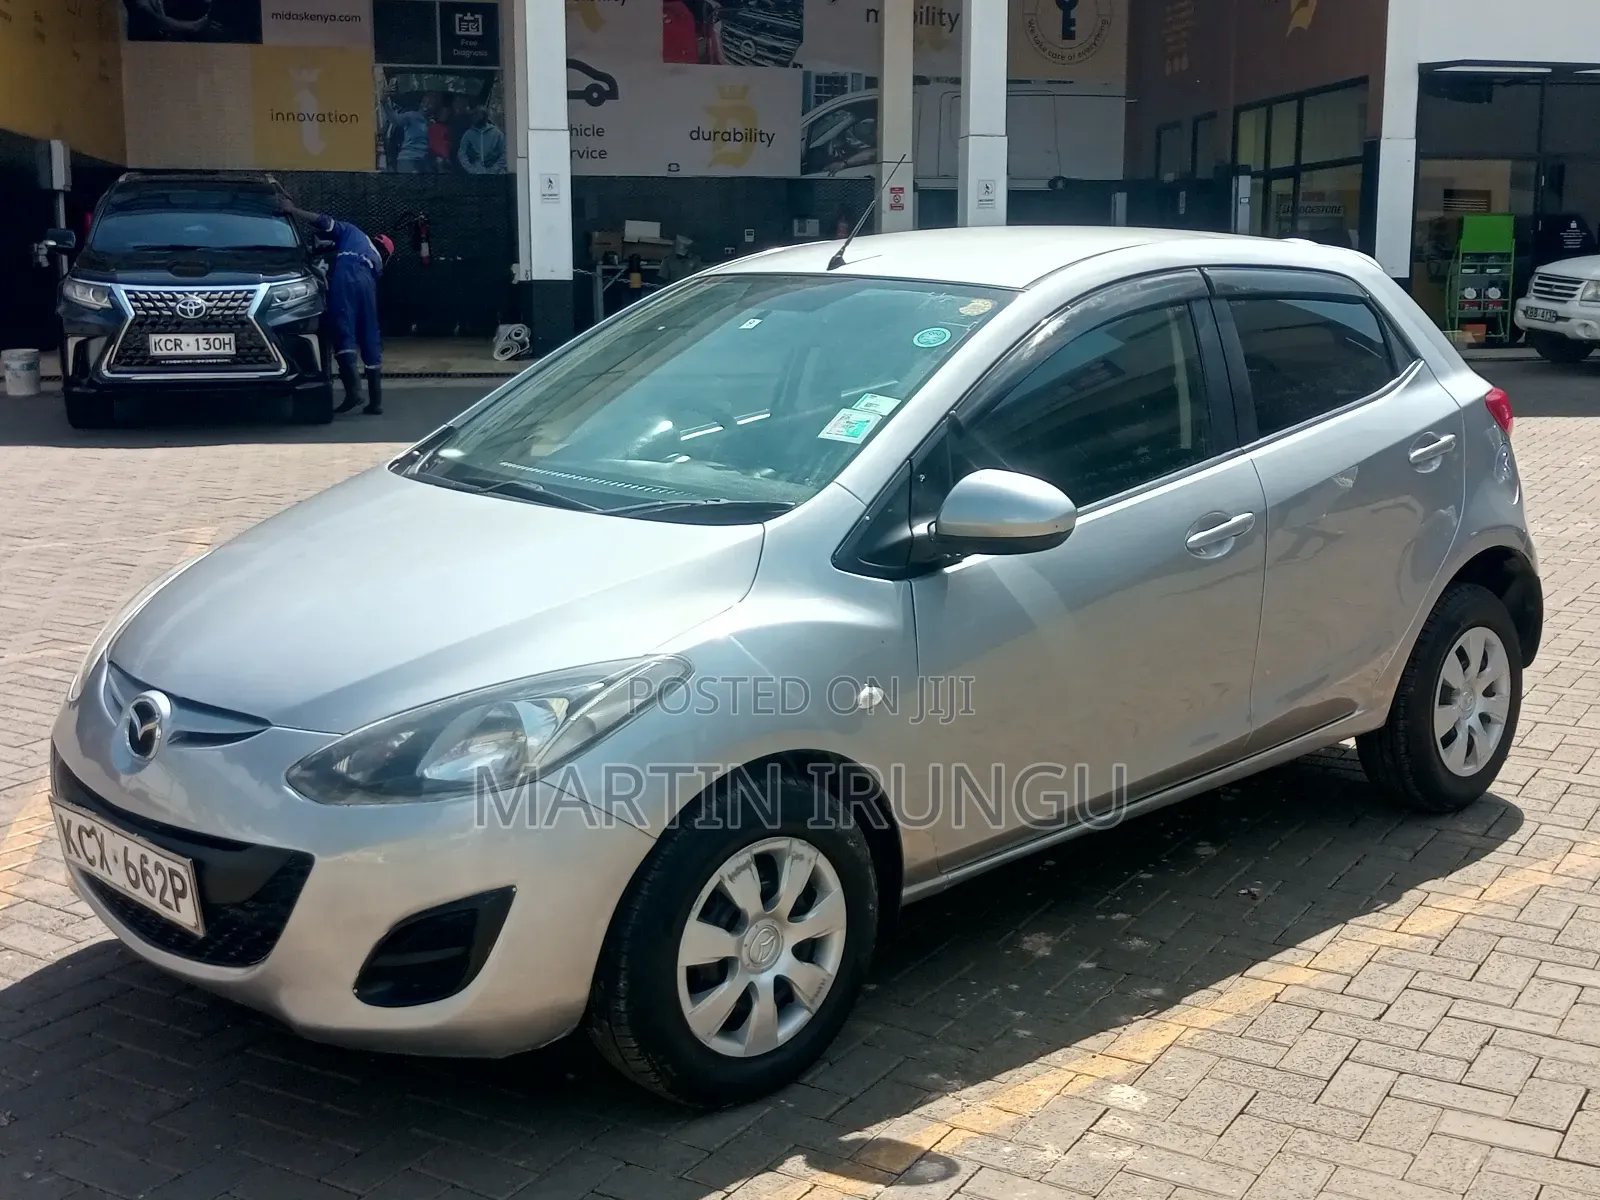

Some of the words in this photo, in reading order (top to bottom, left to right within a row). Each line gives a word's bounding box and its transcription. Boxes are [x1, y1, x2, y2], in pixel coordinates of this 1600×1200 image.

[271, 10, 361, 24] midaskenya.com
[866, 6, 960, 33] mility
[269, 108, 359, 124] innovation
[570, 123, 606, 137] hicle
[689, 126, 776, 148] durability
[570, 146, 608, 159] rvice
